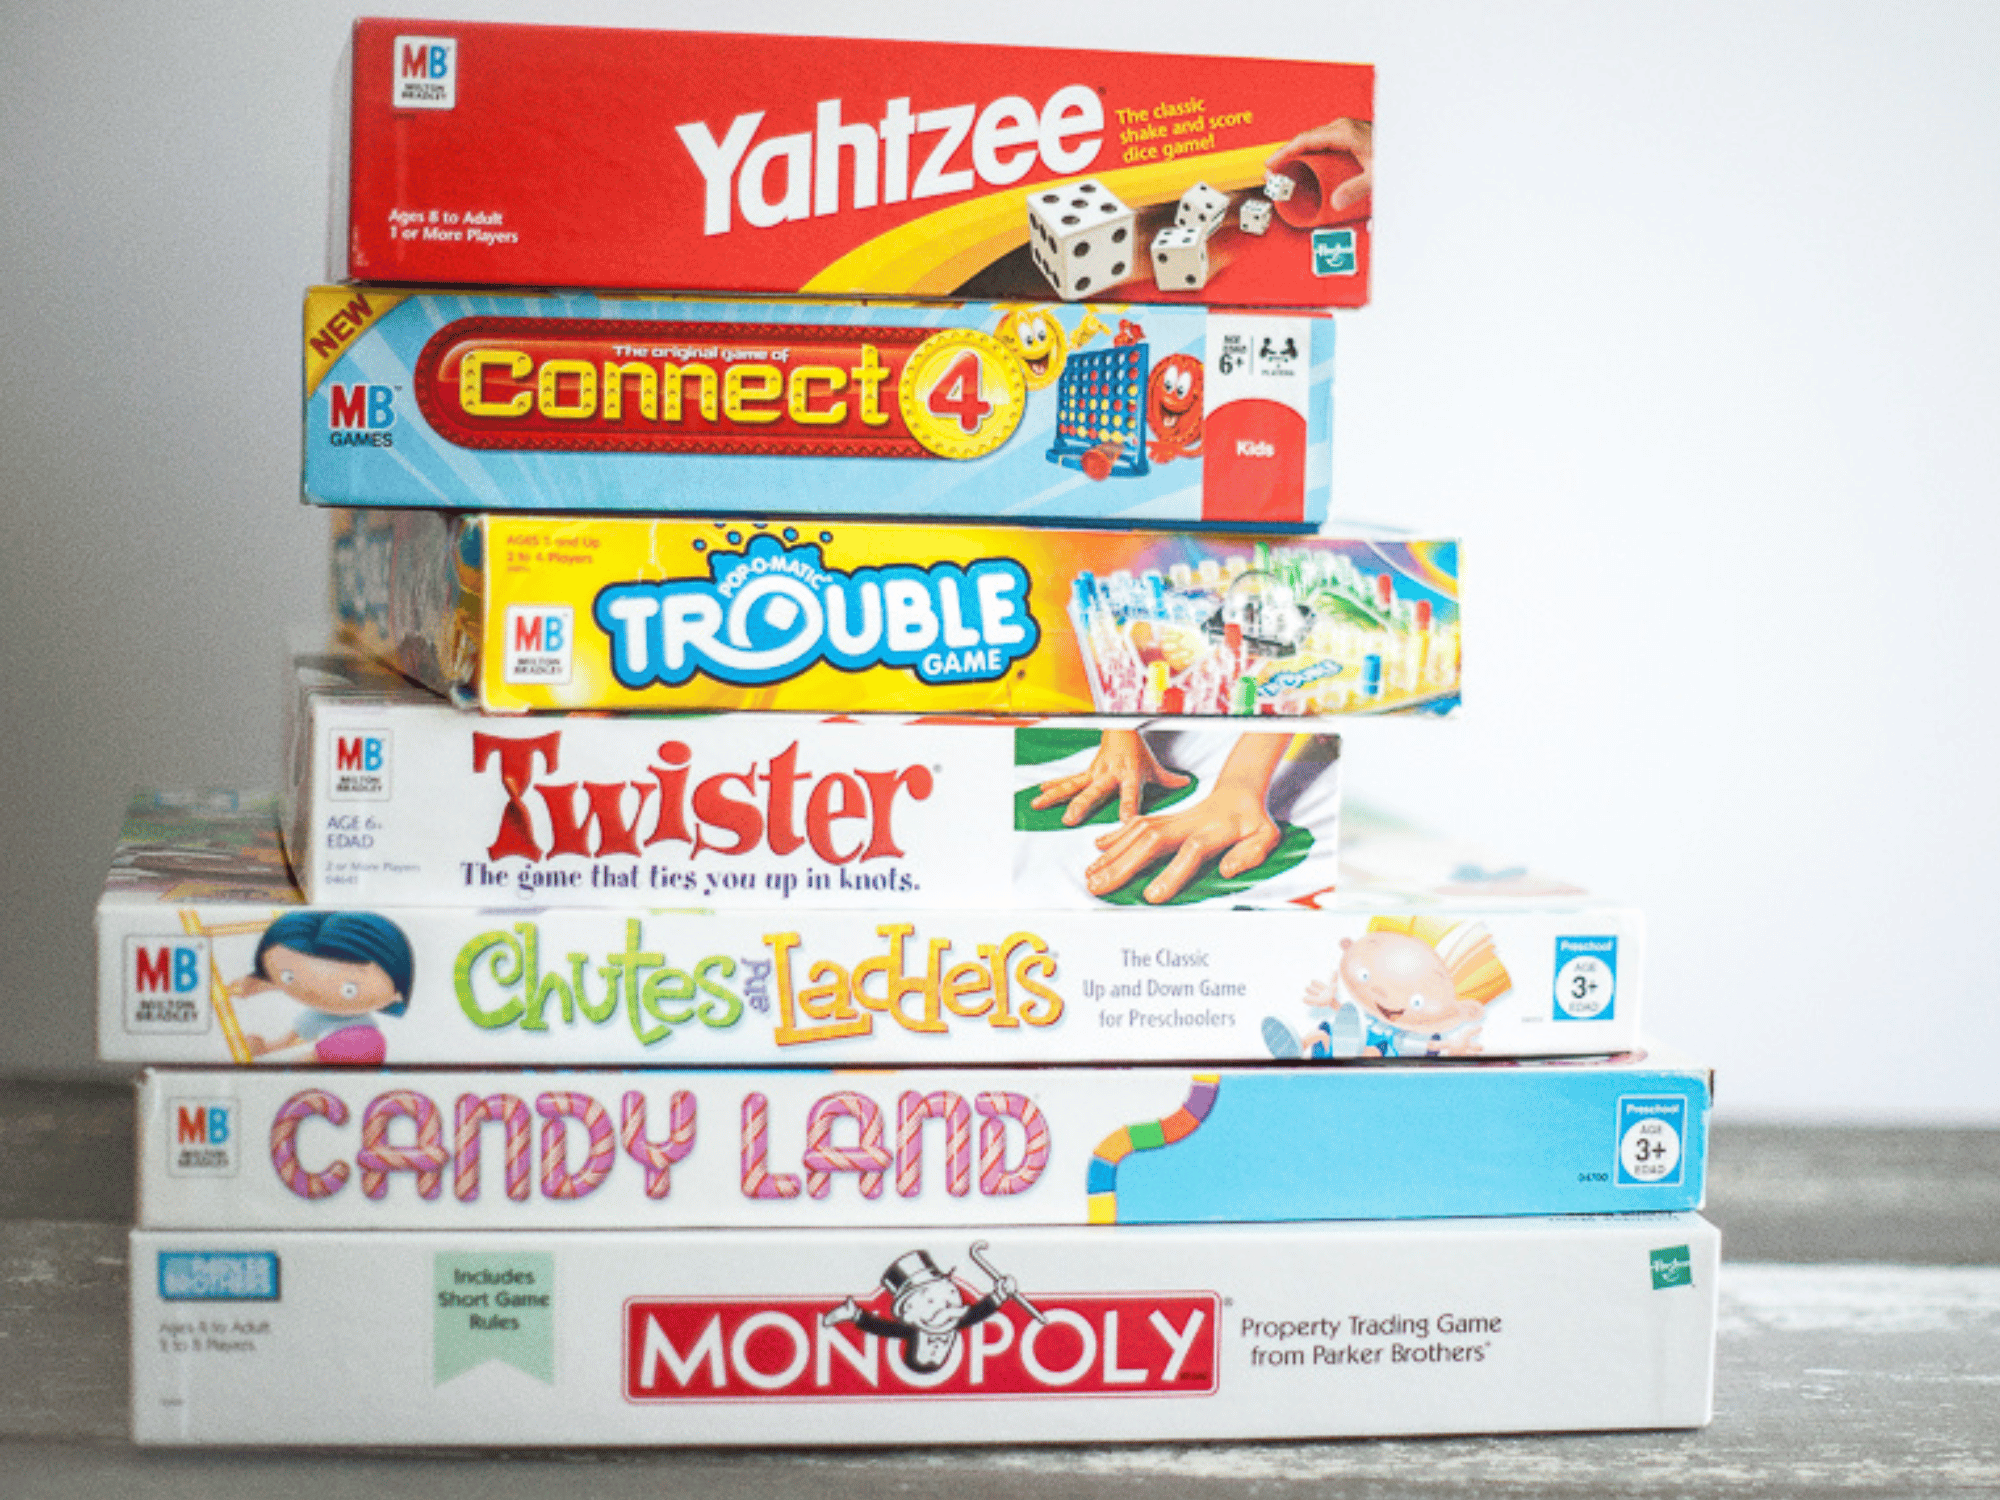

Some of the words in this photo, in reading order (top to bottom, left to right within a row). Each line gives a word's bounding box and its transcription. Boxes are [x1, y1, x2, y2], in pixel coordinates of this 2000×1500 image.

[402, 43, 447, 79] MB
[1114, 107, 1149, 125] The
[1153, 96, 1206, 119] classic
[1119, 123, 1168, 144] shake
[1172, 115, 1204, 135] and
[1208, 110, 1253, 129] score
[675, 84, 1105, 236] Yahtzee
[1122, 146, 1158, 163] dice
[1162, 132, 1215, 162] game!
[388, 208, 424, 227] Ages
[443, 211, 459, 224] to
[462, 210, 503, 225] Adult
[391, 225, 397, 239] 1
[402, 229, 419, 240] or
[423, 227, 463, 241] More
[467, 228, 518, 246] Players
[310, 292, 373, 358] NEW
[612, 345, 648, 357] The
[652, 345, 718, 361] original
[722, 349, 768, 362] game
[772, 349, 790, 363] of
[1219, 352, 1244, 375] 6+
[459, 343, 890, 427] Connect
[928, 350, 991, 433] 4
[331, 384, 394, 429] MB
[329, 431, 393, 447] GAMES
[1236, 440, 1275, 459] Kids
[548, 551, 594, 565] Players
[515, 615, 564, 652] MB
[609, 573, 1026, 670] TROUBLE
[922, 649, 1002, 676] GAME
[336, 736, 383, 771] MB
[472, 730, 934, 866] Twister
[327, 815, 359, 830] AGE
[327, 834, 374, 848] EDAD
[351, 861, 379, 872] More
[383, 862, 421, 873] Players
[460, 862, 508, 887] The
[517, 867, 581, 895] game
[592, 865, 638, 888] that
[650, 864, 698, 889] ties
[704, 871, 756, 896] you
[766, 871, 797, 898] up
[806, 866, 831, 889] in
[840, 867, 920, 891] knots.
[136, 946, 198, 993] MB
[1121, 948, 1151, 967] The
[1155, 947, 1209, 967] Classic
[453, 918, 744, 1046] Chutes
[741, 958, 776, 1014] and
[762, 923, 1065, 1047] Ladders
[1082, 978, 1105, 1002] Up
[1110, 978, 1142, 997] and
[1147, 978, 1195, 997] Down
[1199, 978, 1247, 997] Game
[1571, 976, 1598, 999] 3+
[1099, 1008, 1124, 1028] for
[1129, 1008, 1236, 1028] Preschoolers
[178, 1106, 229, 1144] MB
[270, 1088, 697, 1202] CANDY
[741, 1090, 1051, 1200] LAND
[1634, 1138, 1667, 1161] 3+
[453, 1268, 536, 1285] Includes
[438, 1290, 489, 1308] Short
[494, 1289, 550, 1308] Game
[231, 1320, 271, 1334] Adult
[469, 1313, 520, 1330] Rules
[1241, 1316, 1341, 1341] Property
[1349, 1314, 1430, 1338] Trading
[1436, 1312, 1503, 1334] Game
[640, 1308, 1205, 1389] MONOPOLY
[1251, 1346, 1304, 1365] from
[1312, 1344, 1384, 1365] Parker
[1392, 1342, 1486, 1363] Brothers
